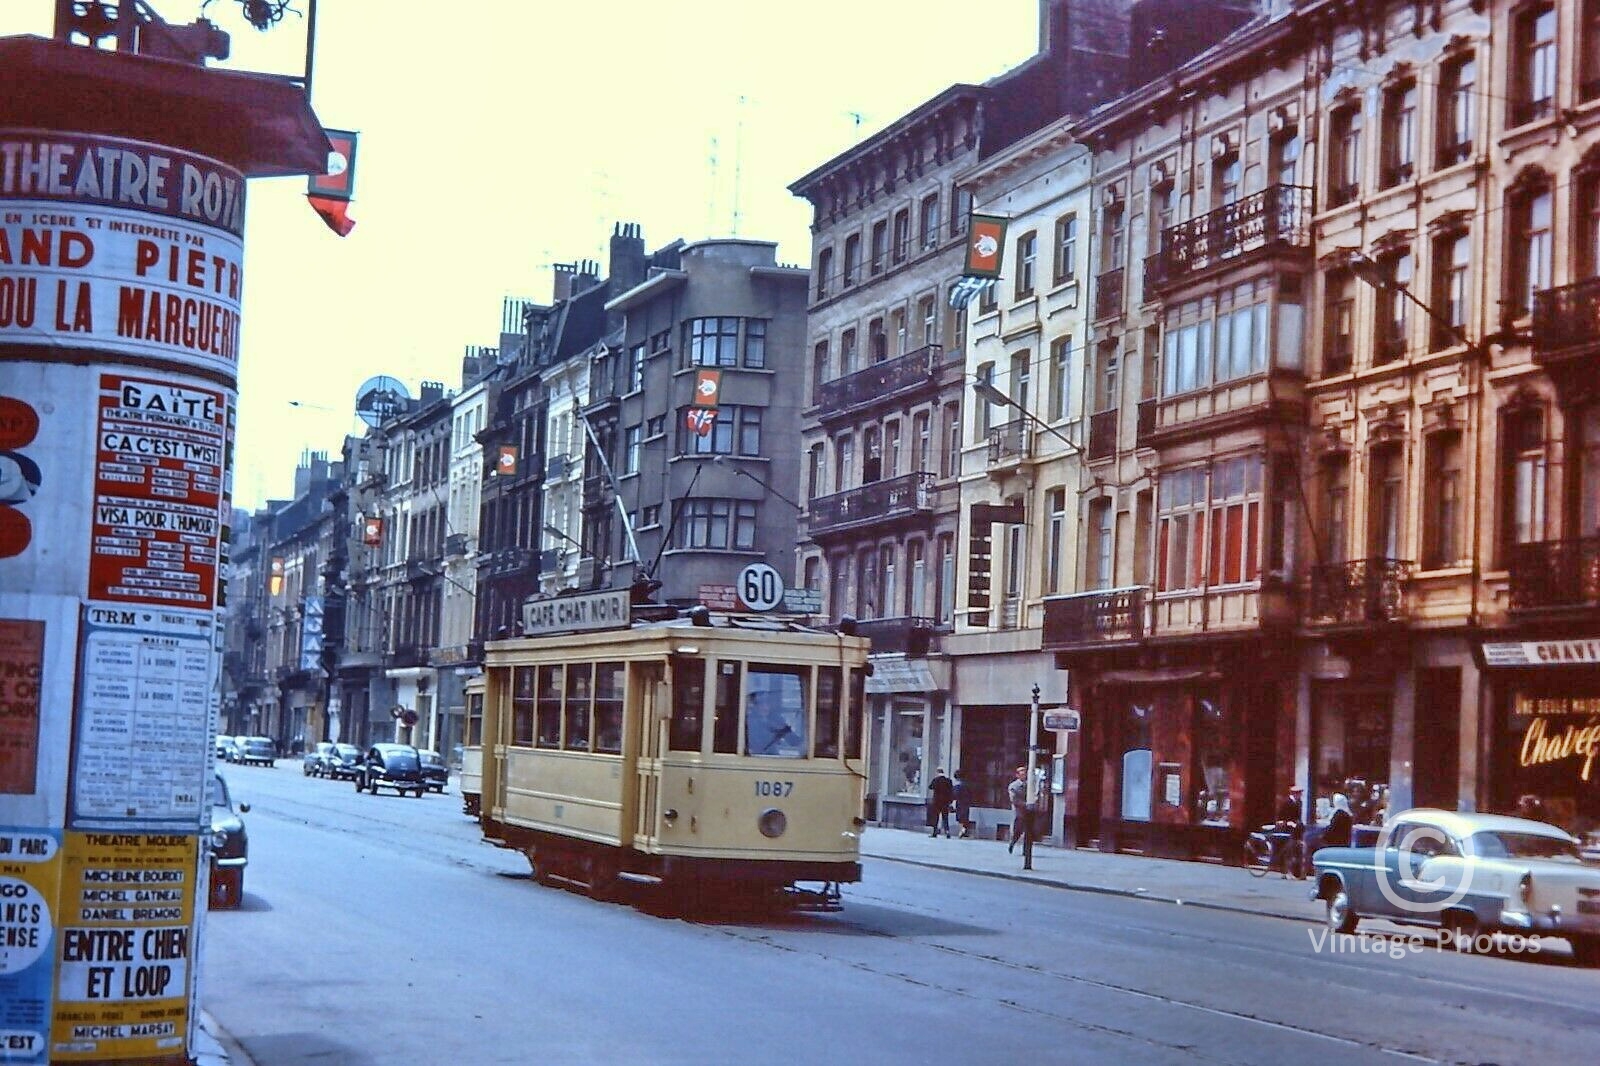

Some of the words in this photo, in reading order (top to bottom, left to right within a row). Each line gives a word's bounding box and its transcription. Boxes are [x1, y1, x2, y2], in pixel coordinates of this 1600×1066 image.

[1, 143, 170, 209] THEATRE
[5, 213, 22, 225] EN
[33, 214, 76, 228] SCENE
[109, 221, 180, 240] INTERPRETE
[185, 232, 205, 248] PAR
[56, 279, 93, 334] LA
[170, 388, 183, 398] LA
[104, 434, 132, 452] CA
[136, 437, 180, 457] C'EST
[100, 507, 129, 525] VISA
[135, 510, 167, 531] POUR
[744, 568, 775, 605] 60
[92, 608, 136, 626] TRM
[558, 600, 586, 625] CHAT
[590, 596, 621, 623] NOIR
[755, 780, 793, 798] 1087
[20, 838, 49, 857] PARC
[85, 834, 141, 847] THEATRE
[4, 865, 27, 874] MAI
[85, 870, 141, 883] MICHELINE
[0, 883, 28, 899] GO
[83, 890, 129, 903] MICHEL
[0, 903, 41, 924] NCS
[82, 908, 127, 921] DANIEL
[63, 929, 136, 962] ENTRE
[143, 928, 188, 961] CHIEN
[87, 966, 115, 998] ET
[124, 964, 172, 998] LOUP
[74, 1025, 124, 1039] MICHEL
